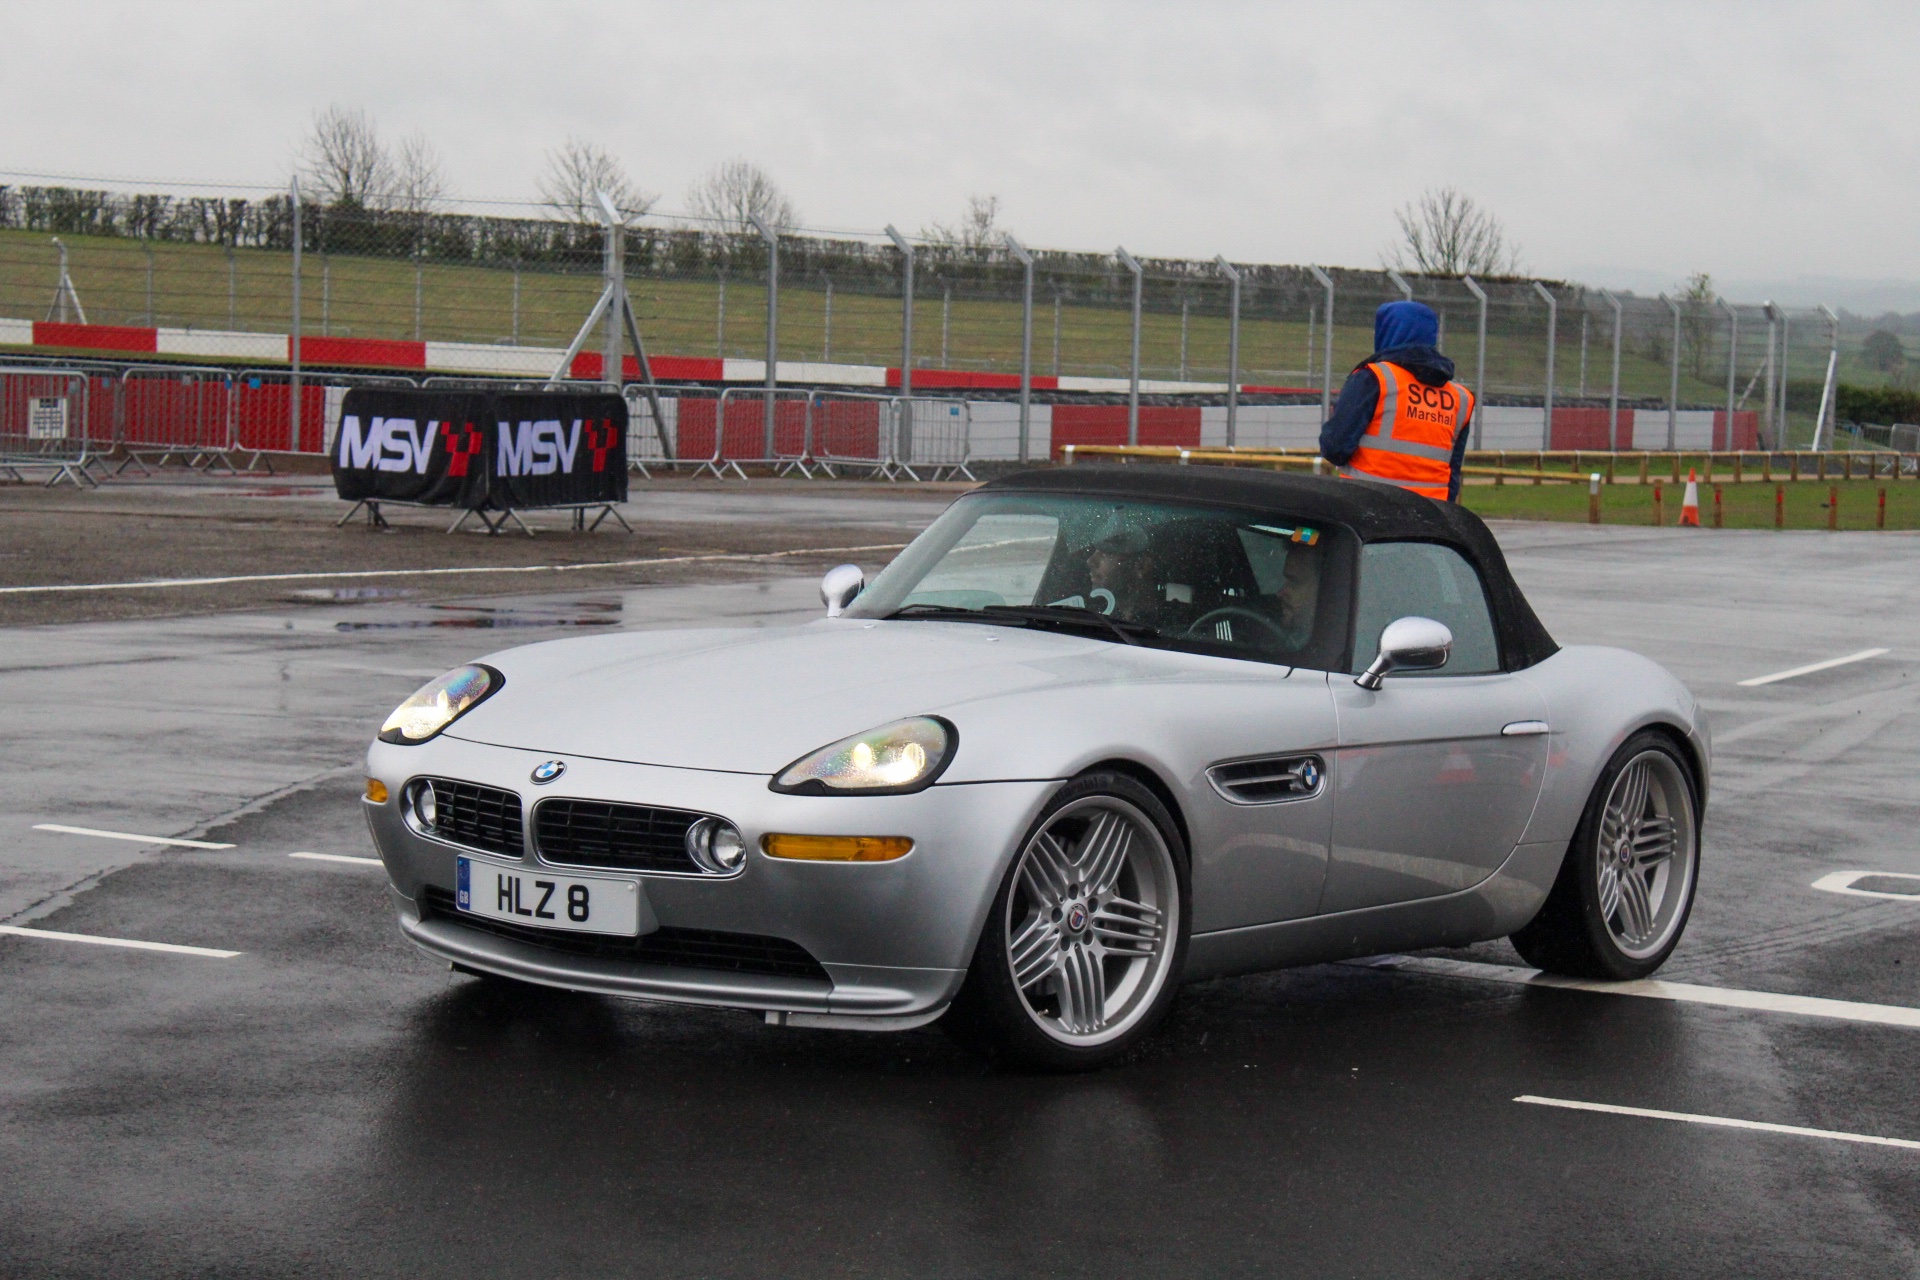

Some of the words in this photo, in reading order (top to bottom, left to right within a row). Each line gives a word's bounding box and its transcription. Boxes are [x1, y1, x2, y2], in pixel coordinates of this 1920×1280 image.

[1406, 405, 1453, 426] Marshal
[1408, 383, 1455, 411] SCD
[339, 415, 439, 475] MSV
[497, 419, 582, 477] MSV
[459, 889, 469, 904] GB
[497, 873, 555, 920] HLZ
[567, 884, 590, 923] 8
